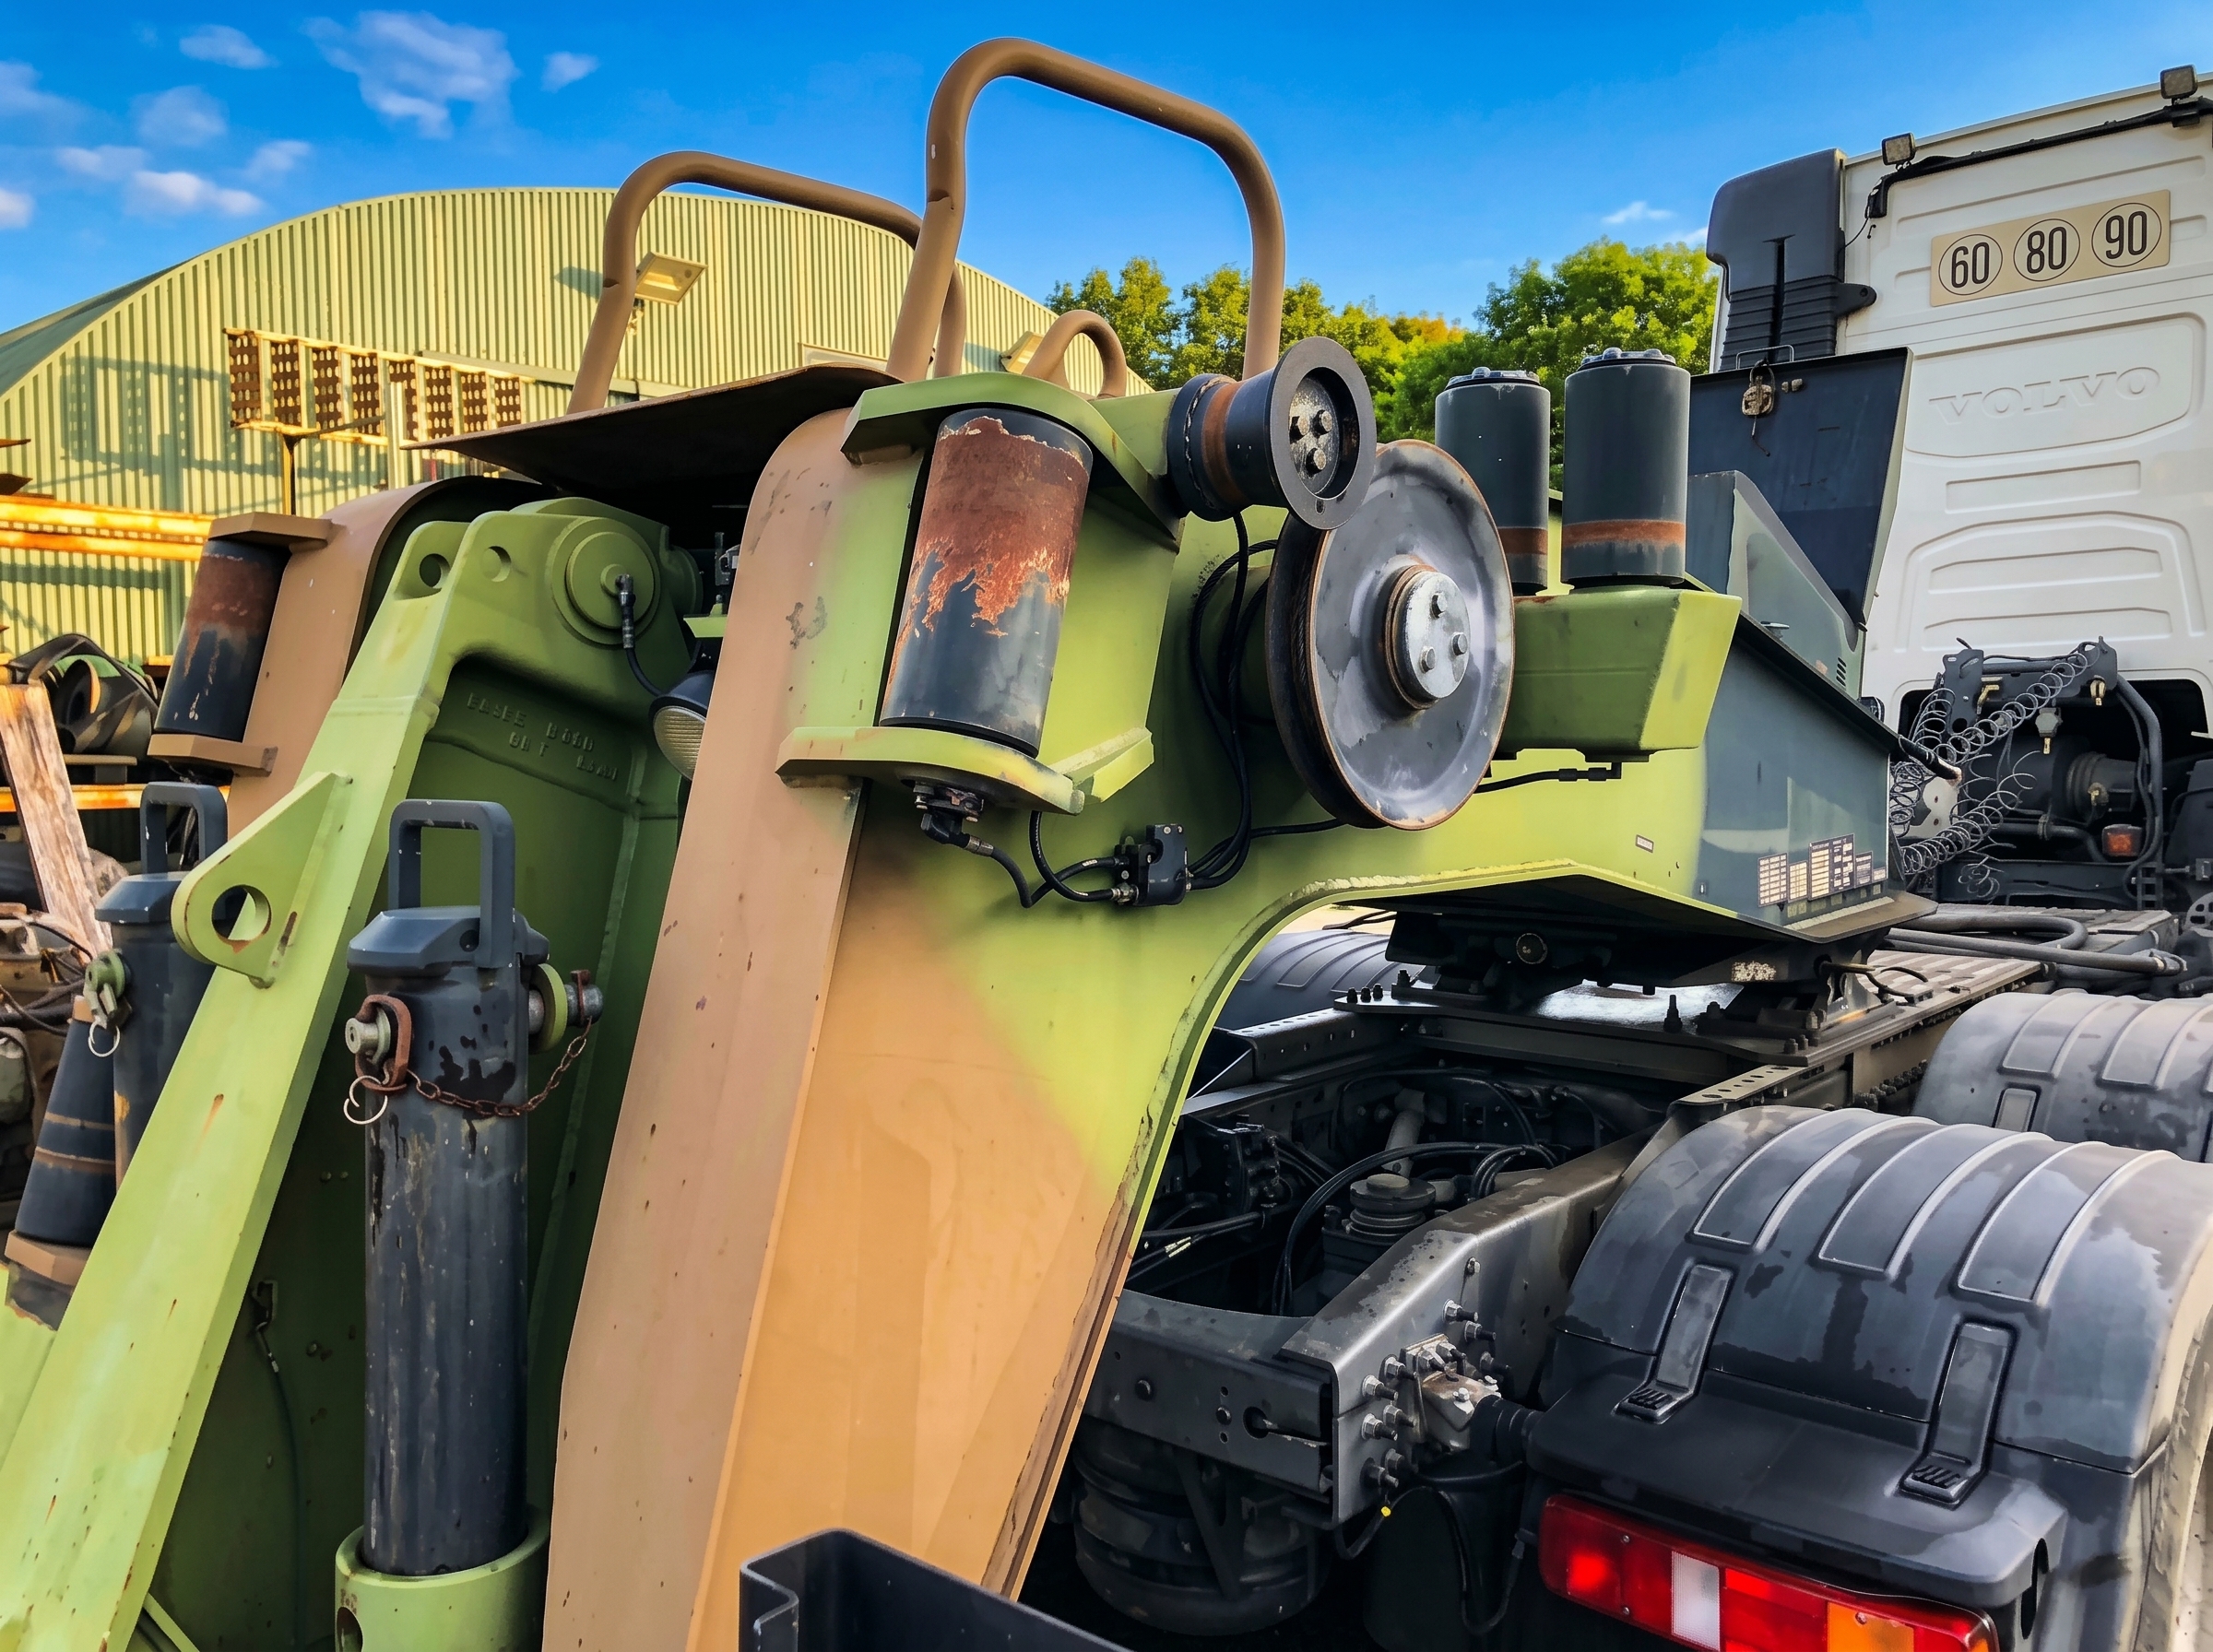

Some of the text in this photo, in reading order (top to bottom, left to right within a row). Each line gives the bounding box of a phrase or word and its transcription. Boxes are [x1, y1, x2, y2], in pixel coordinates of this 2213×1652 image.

[1951, 210, 2148, 289] 60 80 90
[1928, 366, 2161, 426] VOLVO
